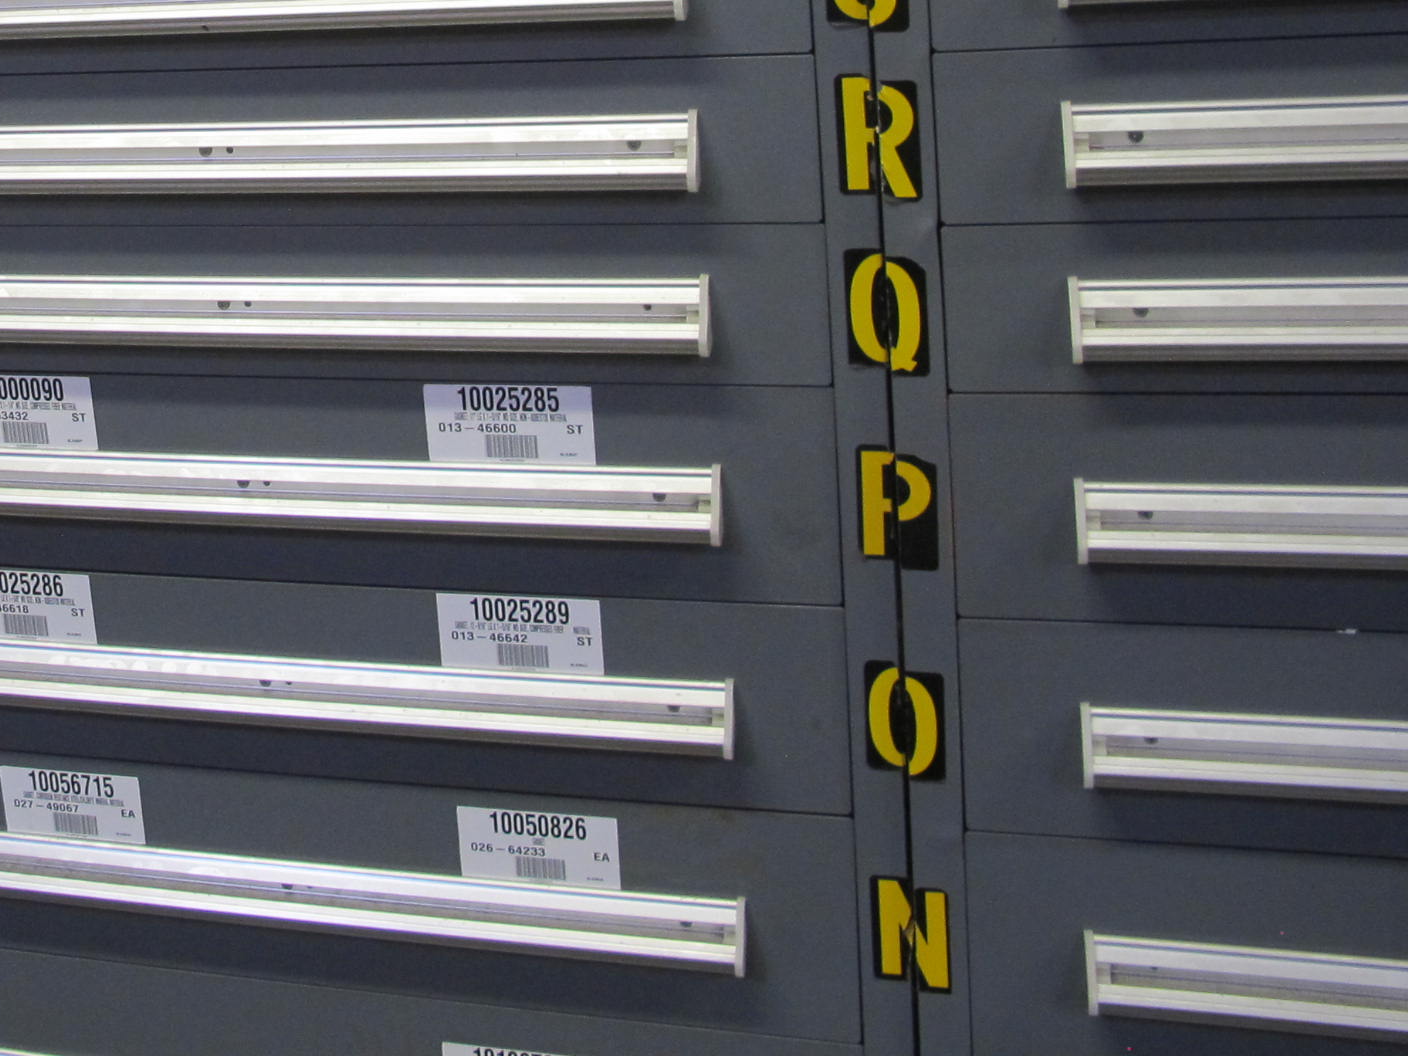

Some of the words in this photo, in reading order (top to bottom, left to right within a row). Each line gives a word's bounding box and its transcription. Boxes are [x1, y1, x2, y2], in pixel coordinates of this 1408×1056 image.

[841, 76, 918, 200] R
[849, 253, 918, 372] Q
[457, 386, 560, 412] 10025285
[72, 412, 86, 422] ST
[566, 424, 584, 435] ST
[860, 450, 933, 556] P
[71, 608, 85, 617] ST
[470, 597, 569, 624] 10025289
[577, 636, 593, 646] ST
[28, 770, 114, 798] 10056715
[121, 809, 135, 819] EA
[490, 811, 587, 841] 10050826
[594, 852, 610, 862] EA
[877, 878, 951, 991] N
